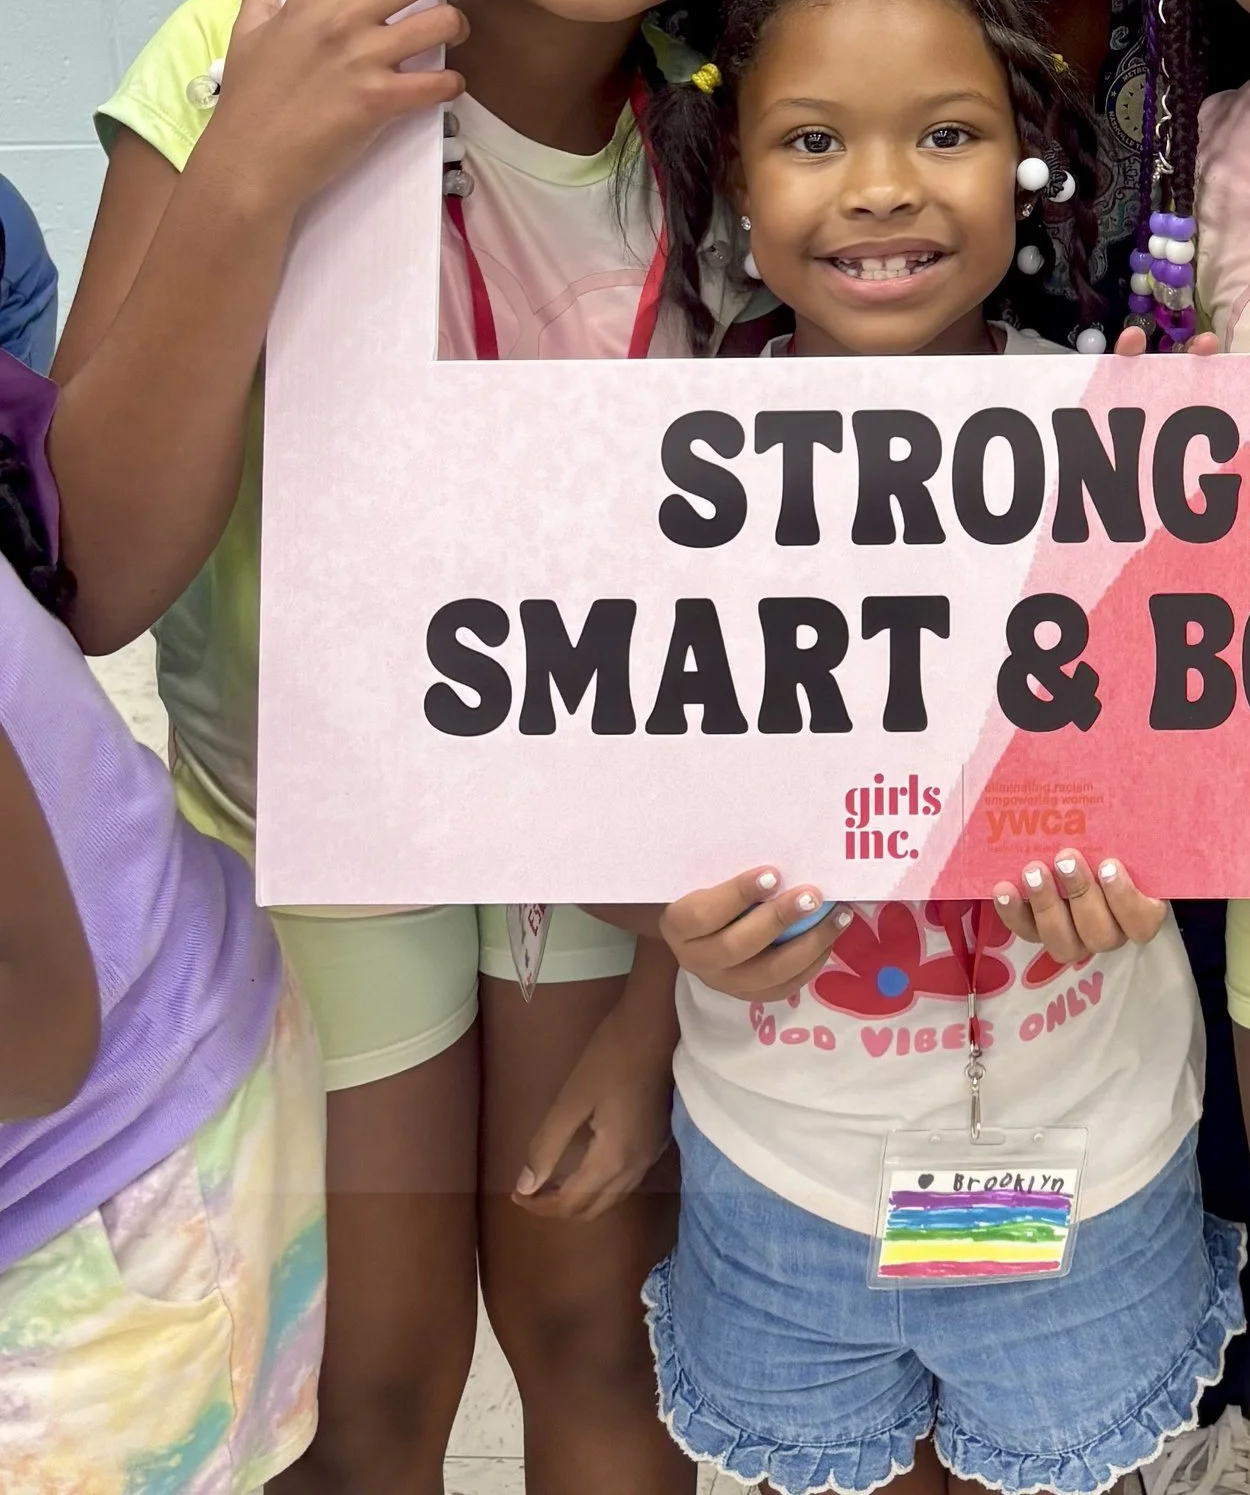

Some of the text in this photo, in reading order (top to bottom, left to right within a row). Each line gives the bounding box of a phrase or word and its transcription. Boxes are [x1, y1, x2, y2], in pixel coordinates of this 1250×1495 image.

[424, 596, 950, 736] SMART
[997, 593, 1102, 732] &
[845, 773, 942, 829] girls
[1062, 795, 1104, 805] women
[845, 817, 919, 860] inc.
[986, 808, 1086, 843] ywca
[860, 1020, 994, 1057] VIBES
[1019, 970, 1104, 1041] ONLY
